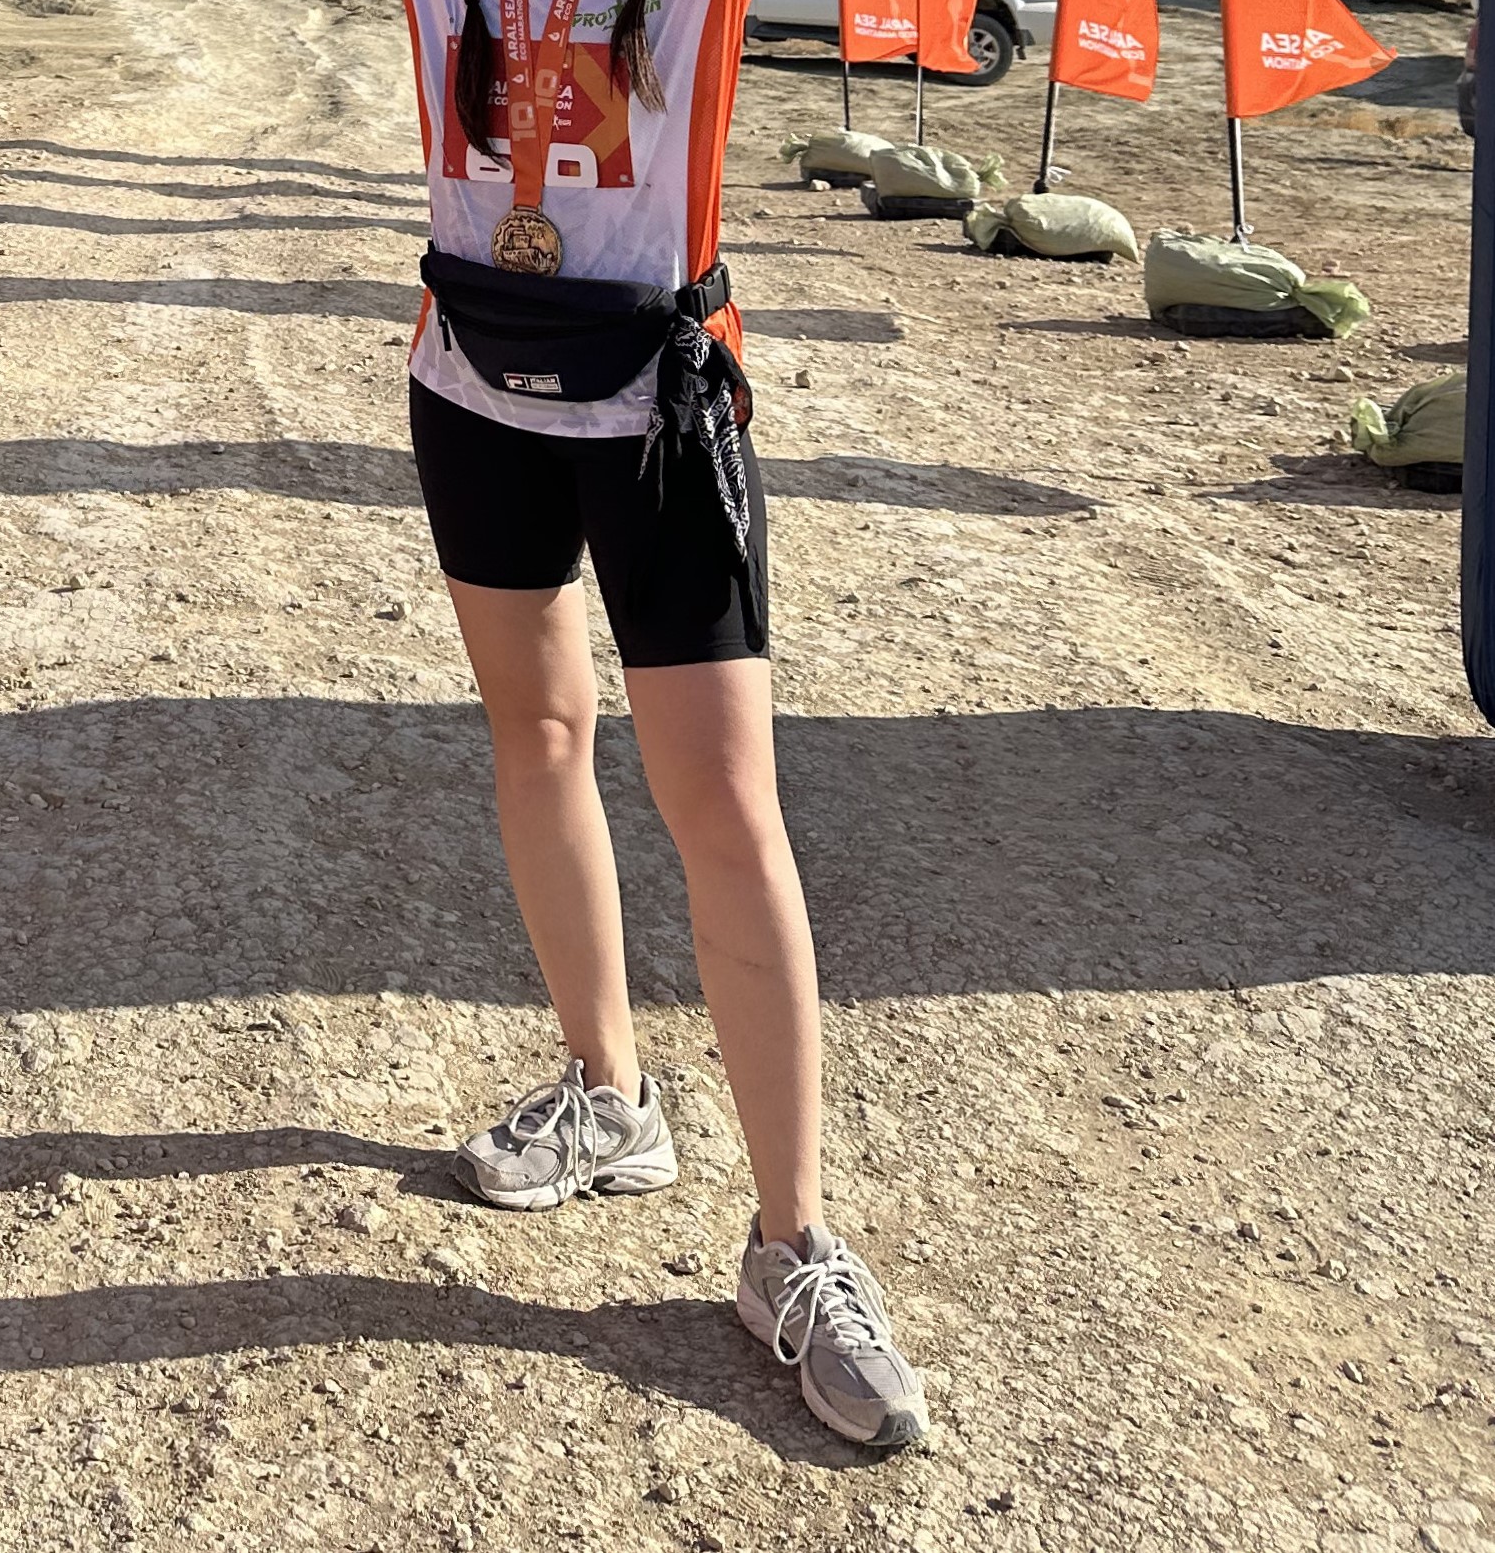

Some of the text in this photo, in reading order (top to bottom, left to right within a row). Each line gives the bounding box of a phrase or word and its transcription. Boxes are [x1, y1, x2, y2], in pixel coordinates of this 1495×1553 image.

[563, 2, 573, 21] ECO
[571, 12, 606, 28] PRO
[506, 22, 519, 61] ARAL
[518, 42, 527, 61] ECO
